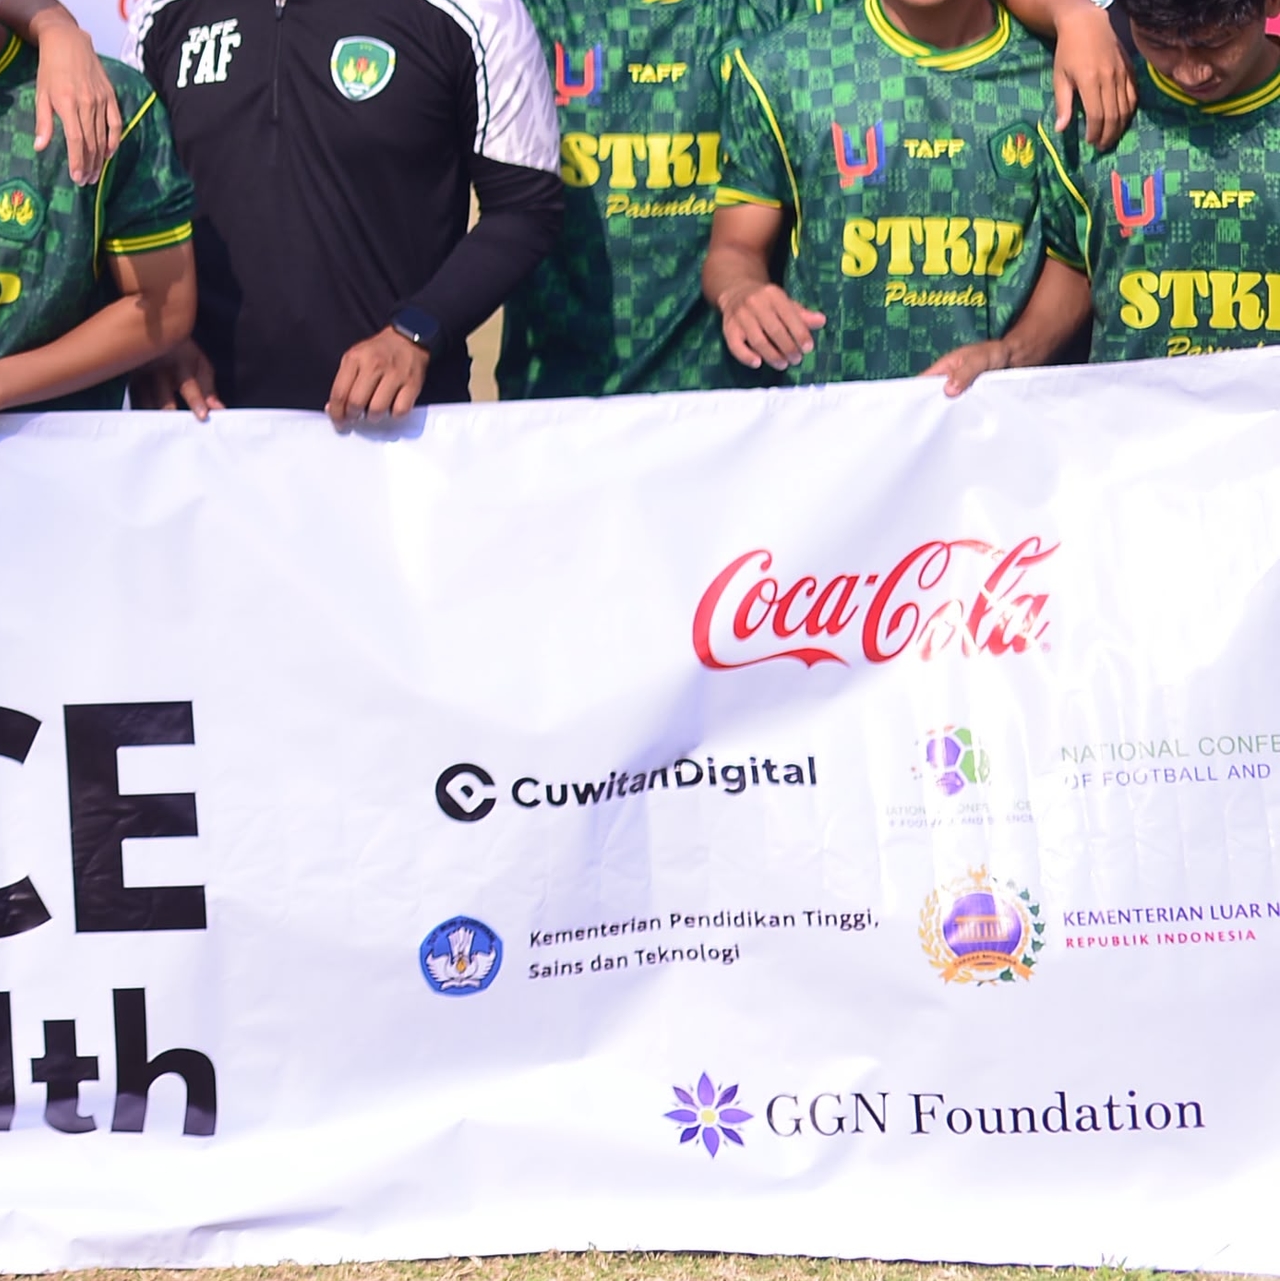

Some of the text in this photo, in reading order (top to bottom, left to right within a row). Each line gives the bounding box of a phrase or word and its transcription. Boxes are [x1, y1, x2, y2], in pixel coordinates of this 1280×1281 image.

[188, 18, 239, 43] TAFF
[176, 31, 241, 89] FAF
[627, 61, 687, 84] TAFF
[560, 130, 730, 190] STKI
[903, 138, 966, 159] TAFF
[1189, 189, 1256, 210] TAFF
[841, 216, 1025, 278] STKIP
[883, 280, 988, 308] Pasunda
[1060, 737, 1189, 765] NATIONAL
[510, 755, 819, 808] CuwitanDigital
[1102, 765, 1219, 788] FOOTBALL
[1227, 762, 1272, 780] AND
[528, 907, 881, 948] Kementerian Pendidikan Tinggi,
[1063, 901, 1280, 927] KEMENTERIAN LUAR N
[1065, 928, 1257, 949] REPUBLIK INDONESIA
[528, 942, 741, 980] Sains dan Teknologi
[765, 1089, 1208, 1138] GGN Foundation
